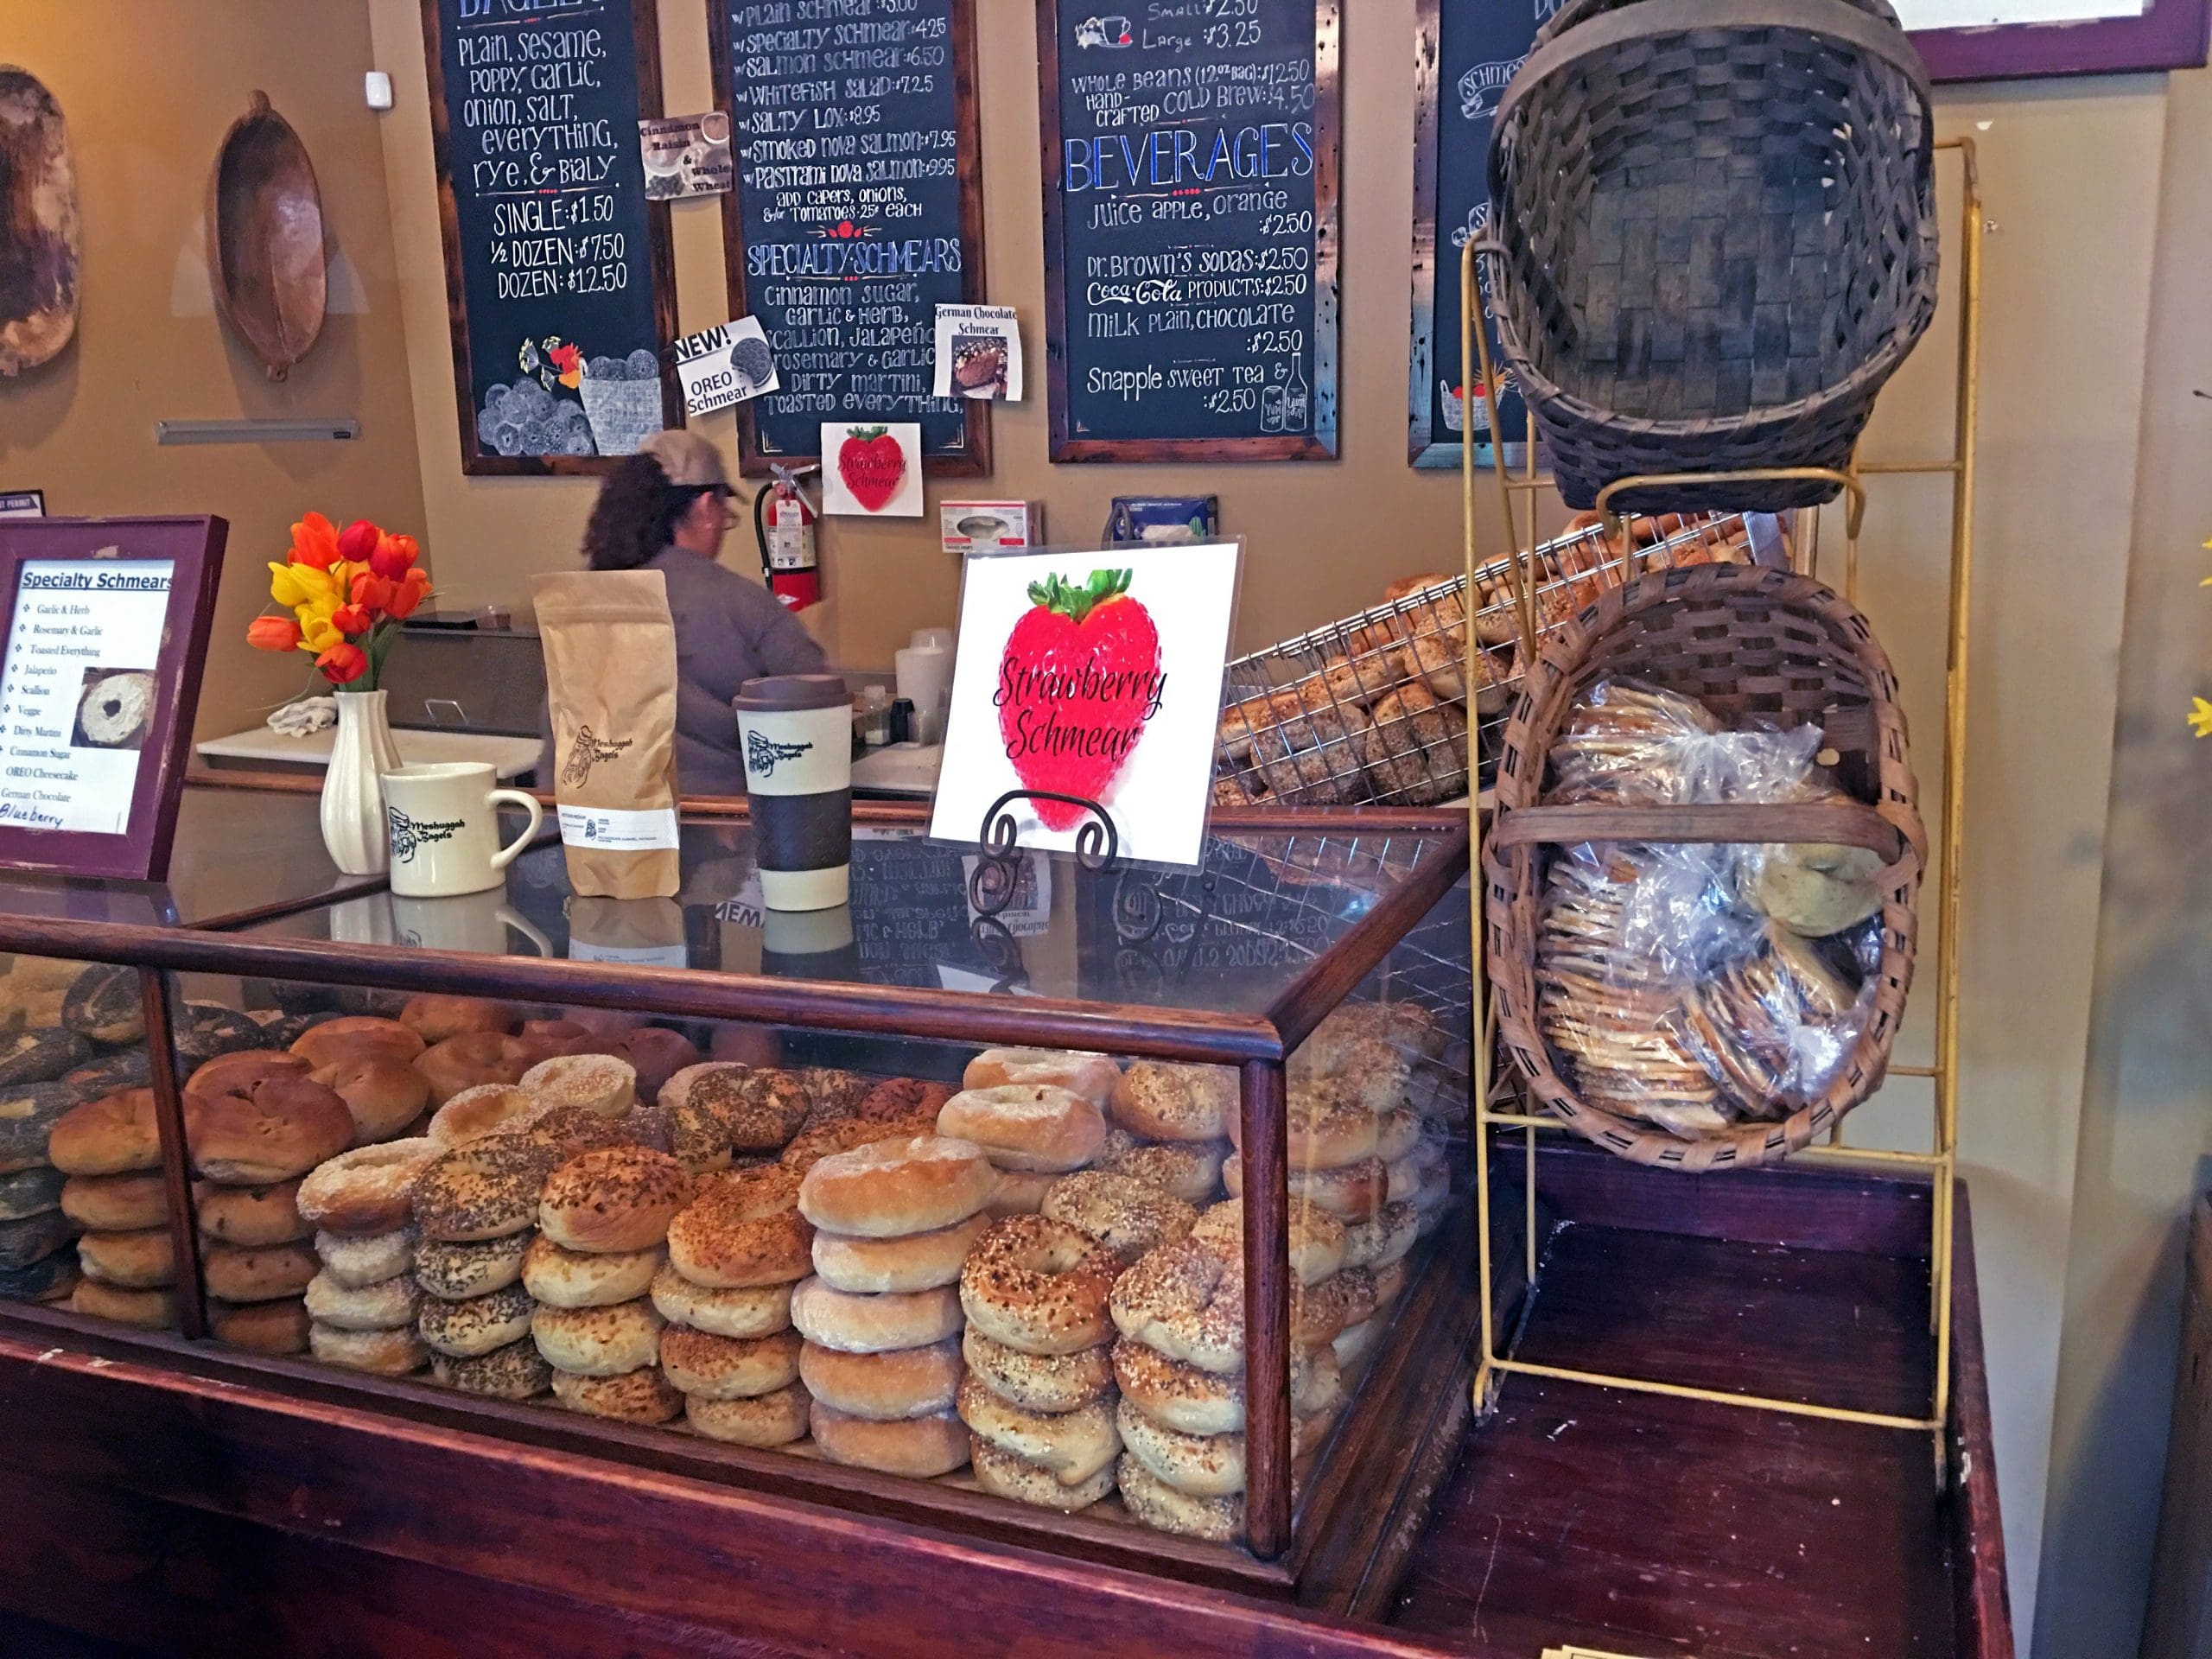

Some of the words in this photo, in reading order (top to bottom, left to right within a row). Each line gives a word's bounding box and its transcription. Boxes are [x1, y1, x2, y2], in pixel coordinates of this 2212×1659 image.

[683, 155, 691, 165] &
[1065, 122, 1313, 192] BEVERAGES
[692, 165, 729, 175] Whole
[692, 181, 730, 192] Wheat
[845, 309, 855, 322] &
[936, 305, 971, 320] German
[958, 322, 999, 335] Schmear
[675, 325, 731, 361] NEW!
[868, 354, 878, 366] &
[691, 372, 732, 396] OREO
[1087, 365, 1162, 401] Snapple
[688, 386, 747, 414] Schmear
[22, 572, 92, 588] Specialty
[97, 573, 173, 589] Schmears
[993, 657, 1167, 721] Strawberry
[1007, 709, 1144, 762] Schmear
[6, 766, 32, 777] OREO
[0, 803, 63, 830] Blueberry
[410, 819, 465, 831] Meshuggah
[417, 831, 452, 842] Bagels
